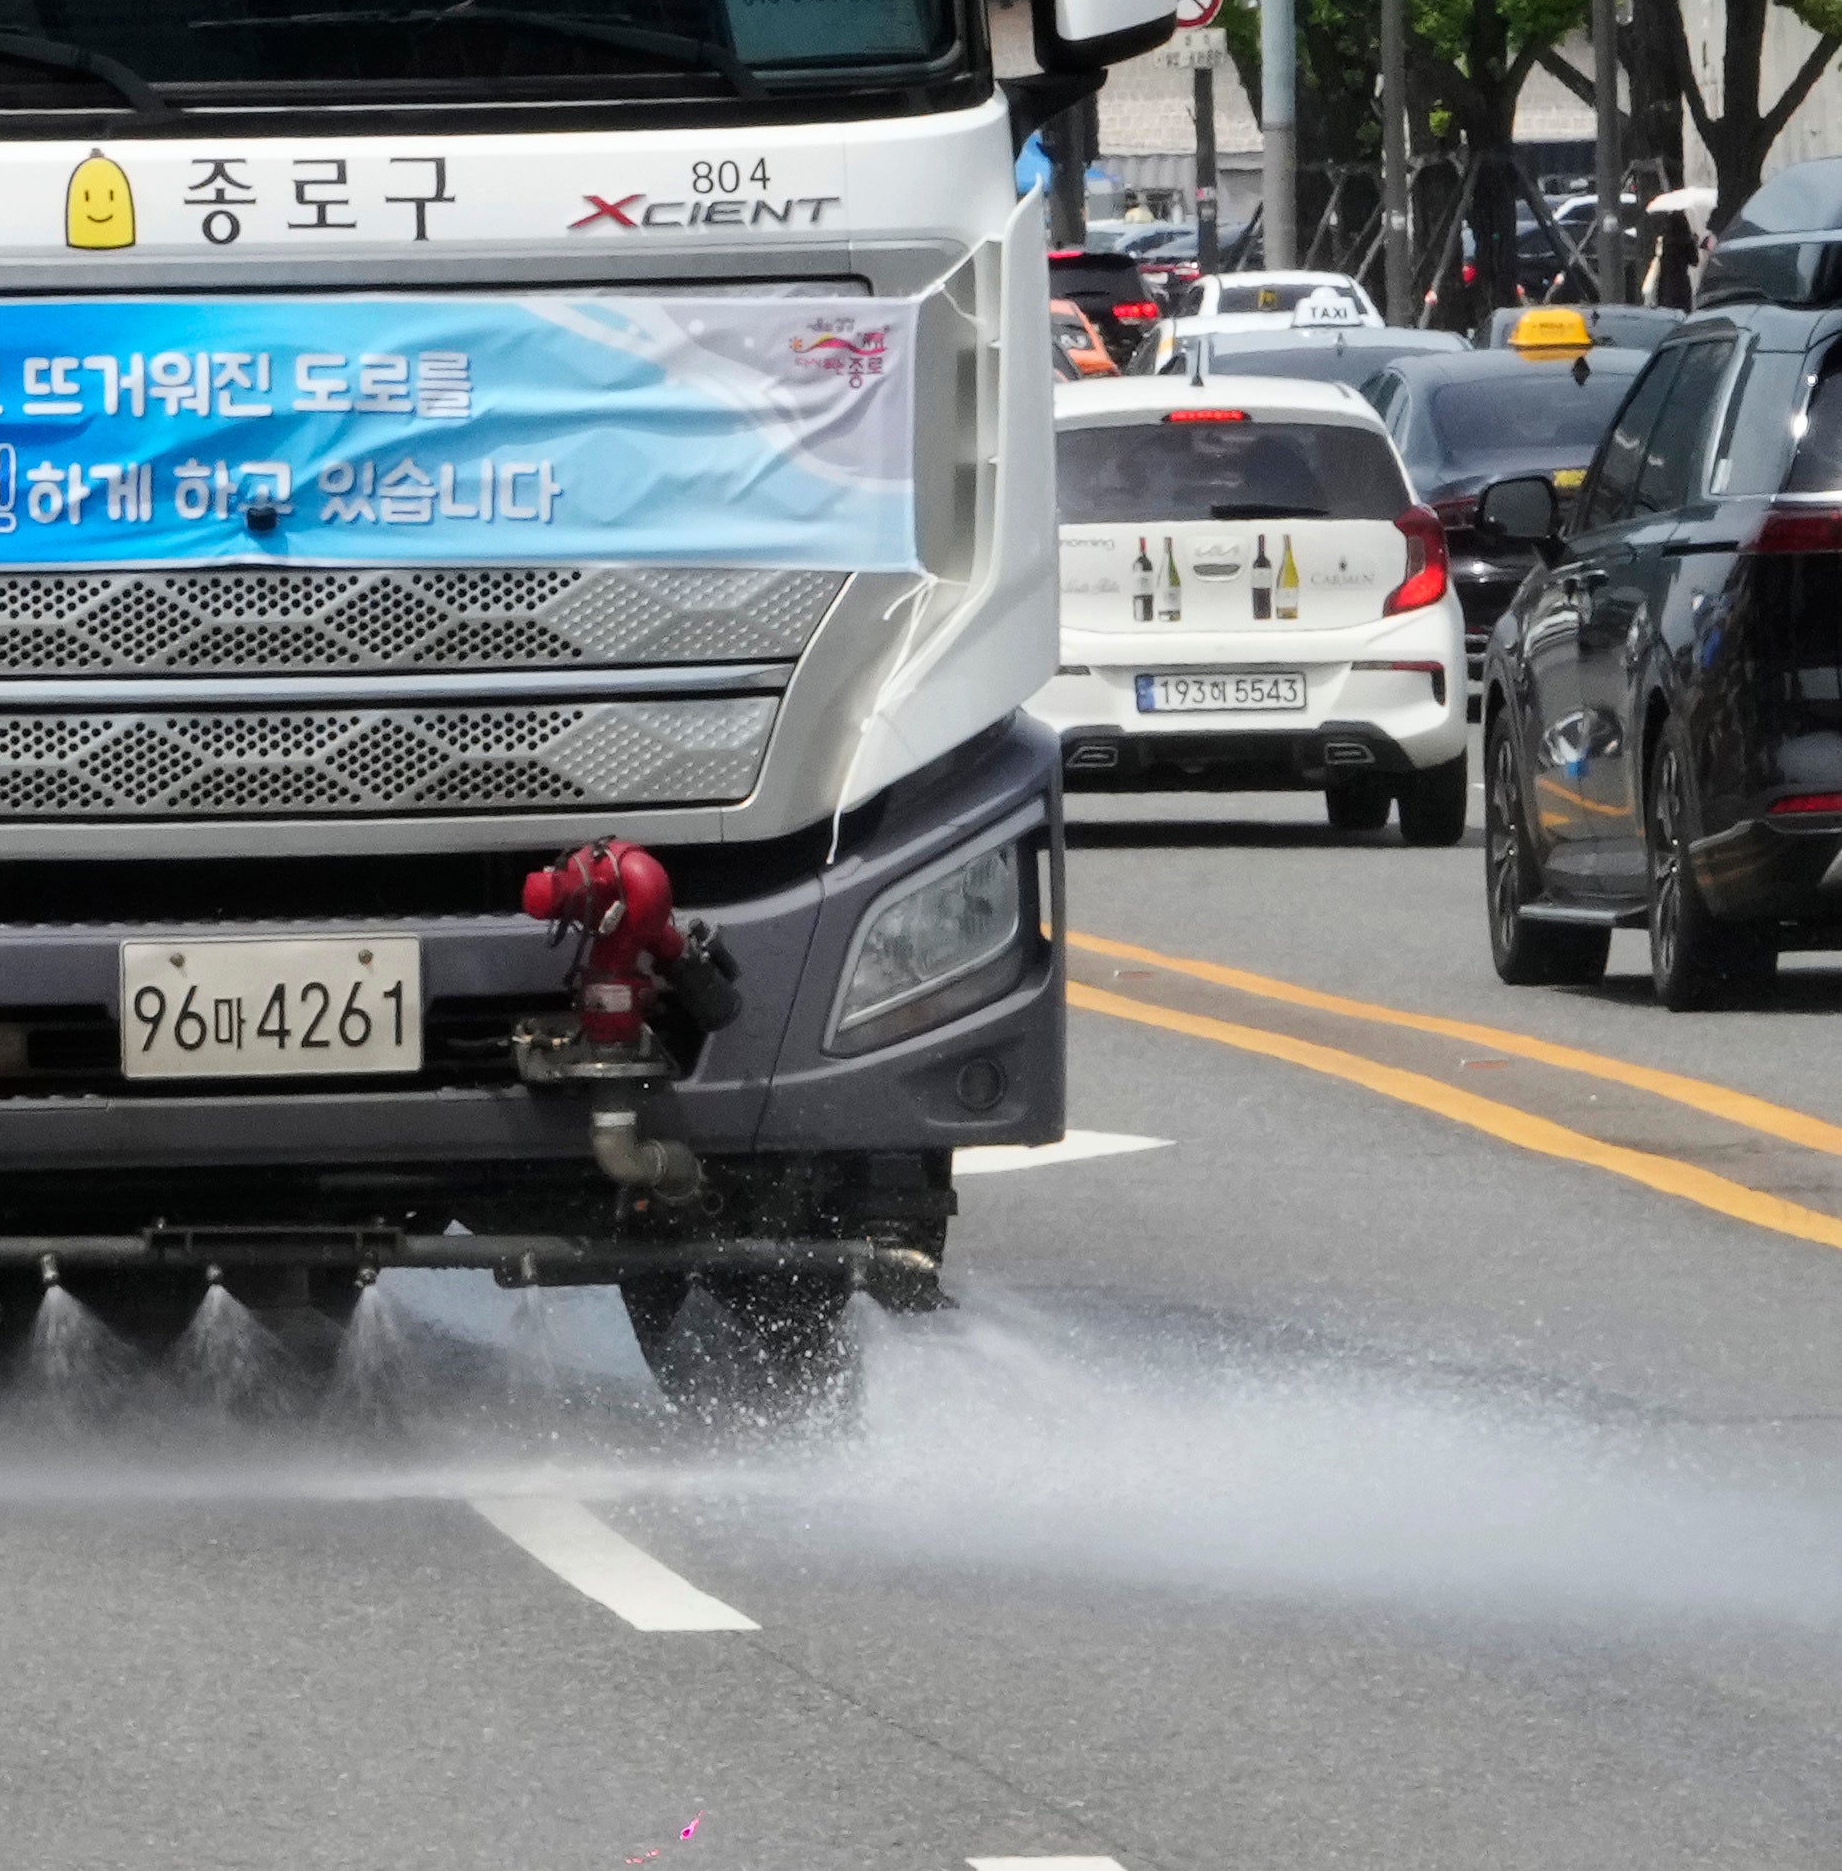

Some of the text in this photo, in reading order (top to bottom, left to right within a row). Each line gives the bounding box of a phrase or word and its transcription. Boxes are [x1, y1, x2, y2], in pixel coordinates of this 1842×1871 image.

[183, 157, 457, 246] 종로구
[691, 157, 773, 194] 804
[566, 194, 841, 229] XCIENT
[1310, 307, 1348, 320] TAXI
[22, 352, 274, 418] 뜨거워진
[292, 351, 474, 419] 도로를
[173, 458, 295, 523] 하고
[318, 457, 564, 525] 있습니다
[1235, 680, 1298, 703] 5543
[132, 979, 406, 1052] 96마4261
